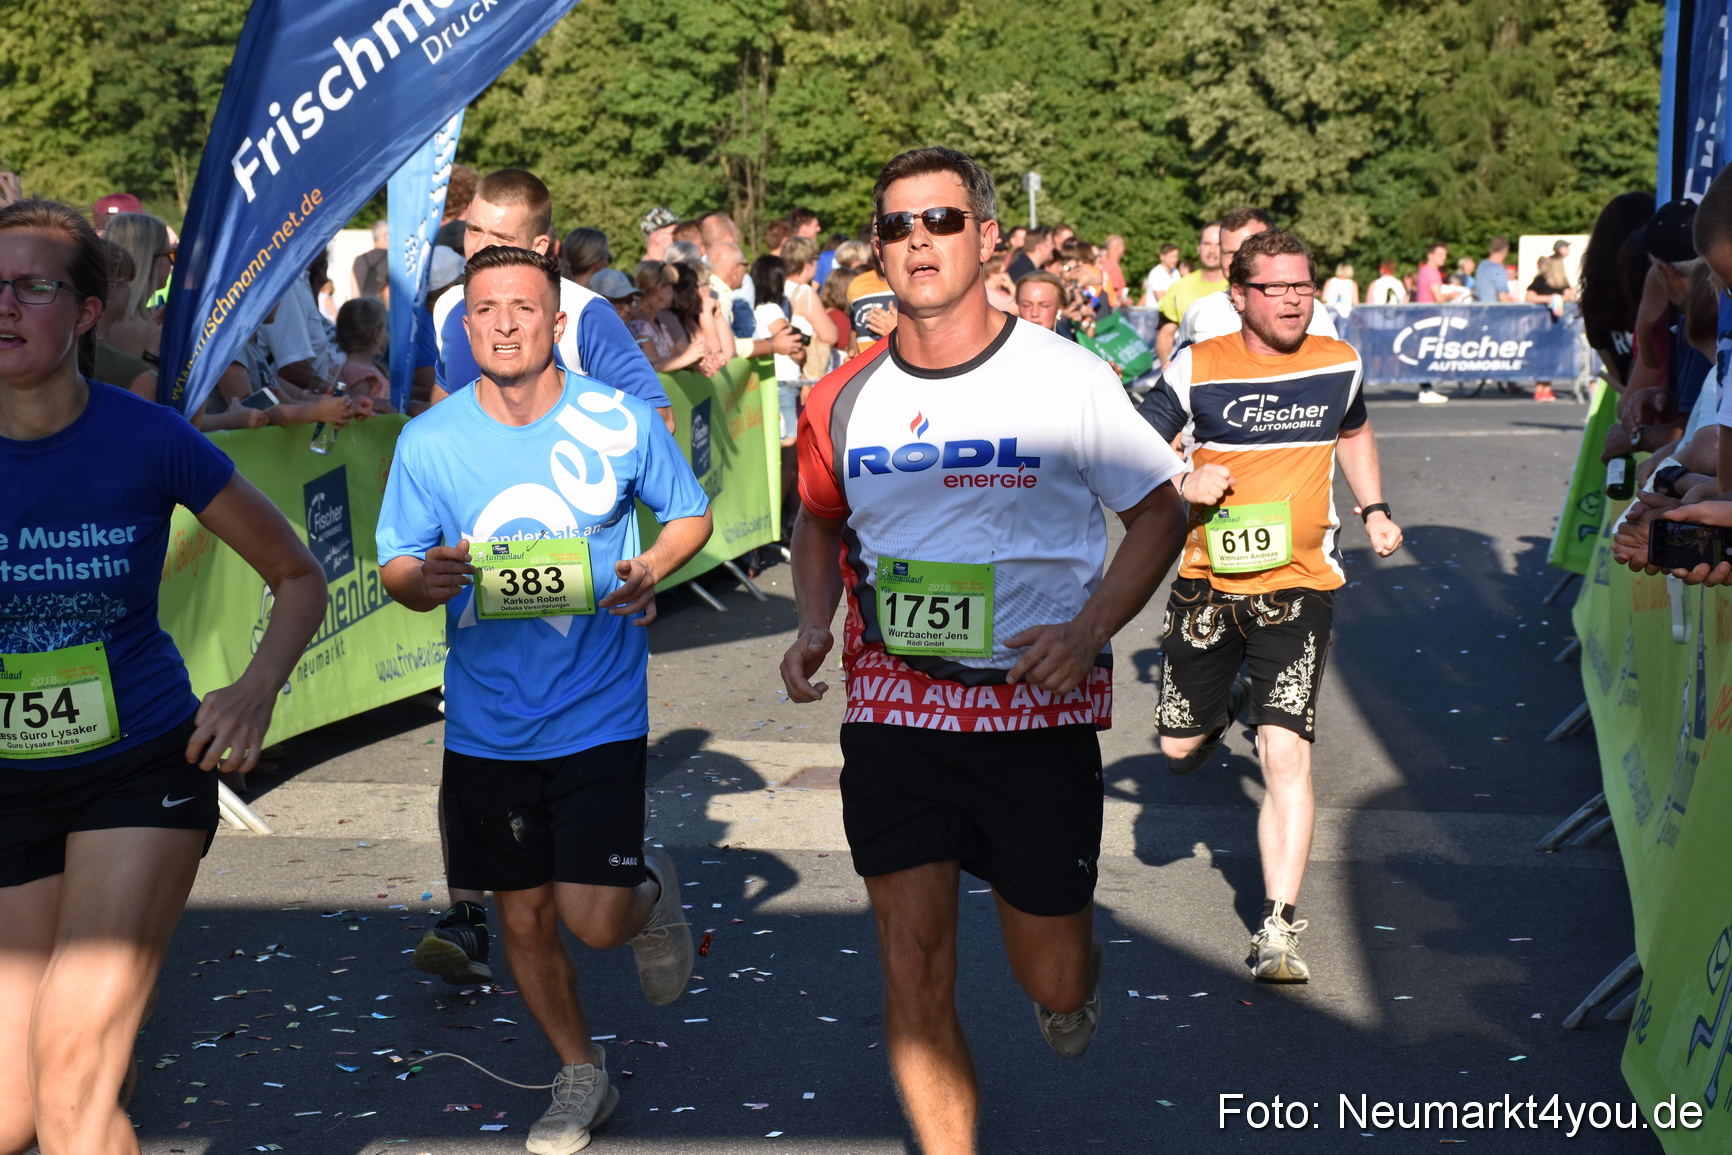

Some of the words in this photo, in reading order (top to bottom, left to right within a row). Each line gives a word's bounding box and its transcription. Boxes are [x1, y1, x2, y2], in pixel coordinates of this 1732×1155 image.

[231, 0, 455, 203] Frischm
[1417, 335, 1533, 360] Fischer
[1427, 359, 1523, 372] AUTOMOBILE
[1243, 402, 1328, 423] Fischer
[1250, 420, 1322, 432] AUTOMOBILE
[313, 504, 343, 534] Fischer
[19, 523, 137, 550] Musiker
[490, 529, 551, 542] anders
[555, 525, 581, 539] als
[1222, 528, 1271, 554] 619
[486, 552, 525, 561] firmenlauf
[1219, 554, 1249, 562] Wittmann
[1250, 551, 1279, 560] Andreas
[0, 554, 130, 582] tschistin
[498, 566, 565, 597] 383
[928, 583, 951, 592] 2018
[503, 596, 535, 605] Karkos
[536, 595, 567, 603] Robert
[523, 603, 570, 611] Versicherungen
[886, 592, 970, 630] 1751
[888, 628, 943, 640] Wurzbacher
[945, 632, 969, 641] Jens
[296, 635, 346, 683] neumarkt
[30, 675, 58, 687] 2018
[850, 672, 914, 705] AVIA
[922, 683, 1001, 709] AVIA
[1010, 681, 1086, 709] AVIA
[0, 687, 80, 729] 754
[883, 707, 962, 733] AVIA
[973, 708, 1050, 733] AVIA
[19, 730, 48, 741] Guro
[50, 724, 98, 740] Lysaker
[7, 741, 24, 749] Guro
[24, 741, 55, 751] Lysaker
[57, 737, 80, 746] Næss
